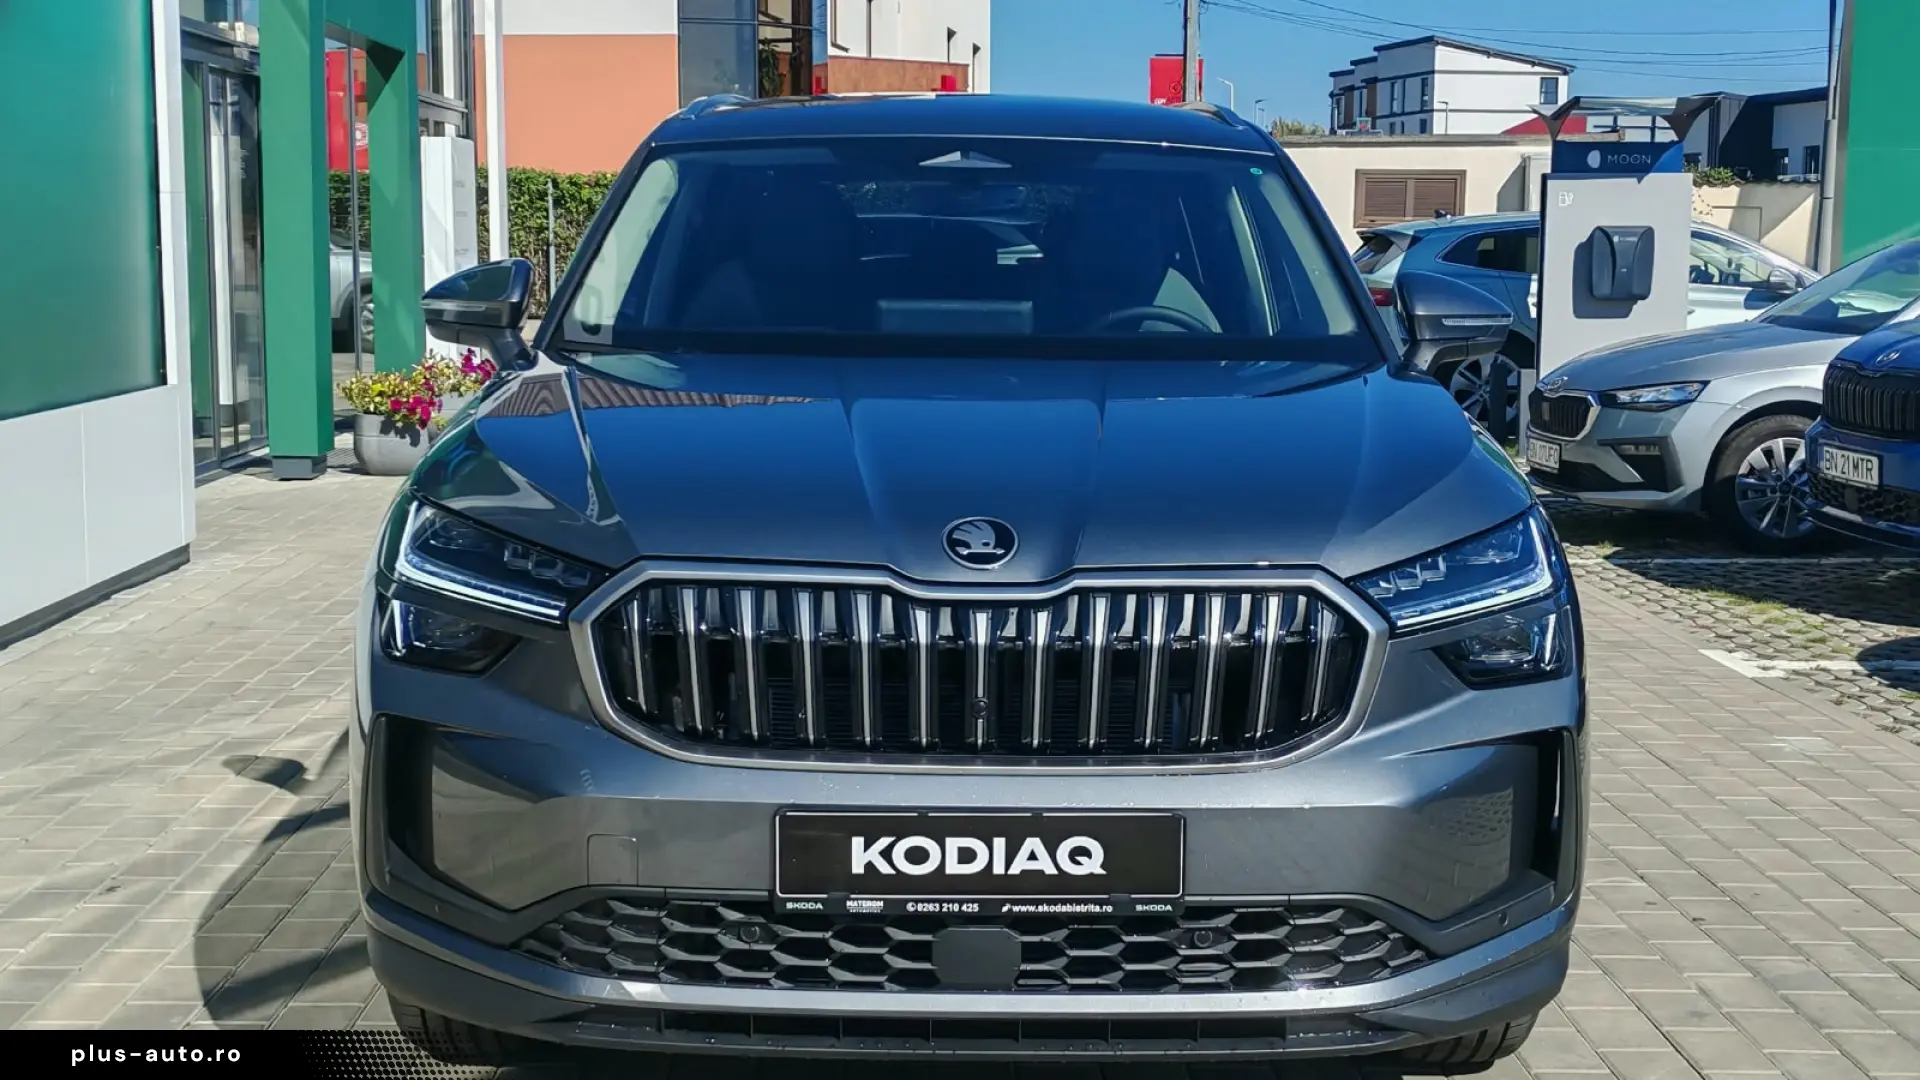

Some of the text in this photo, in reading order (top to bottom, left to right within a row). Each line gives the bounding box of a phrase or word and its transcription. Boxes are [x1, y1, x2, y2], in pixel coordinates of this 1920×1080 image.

[1607, 154, 1651, 165] MOON
[1825, 450, 1873, 481] BN 21 MTR
[851, 835, 1107, 876] KODIAQ
[917, 902, 979, 912] 0263 210 425
[1012, 903, 1113, 913] www.skodabistrita.ro
